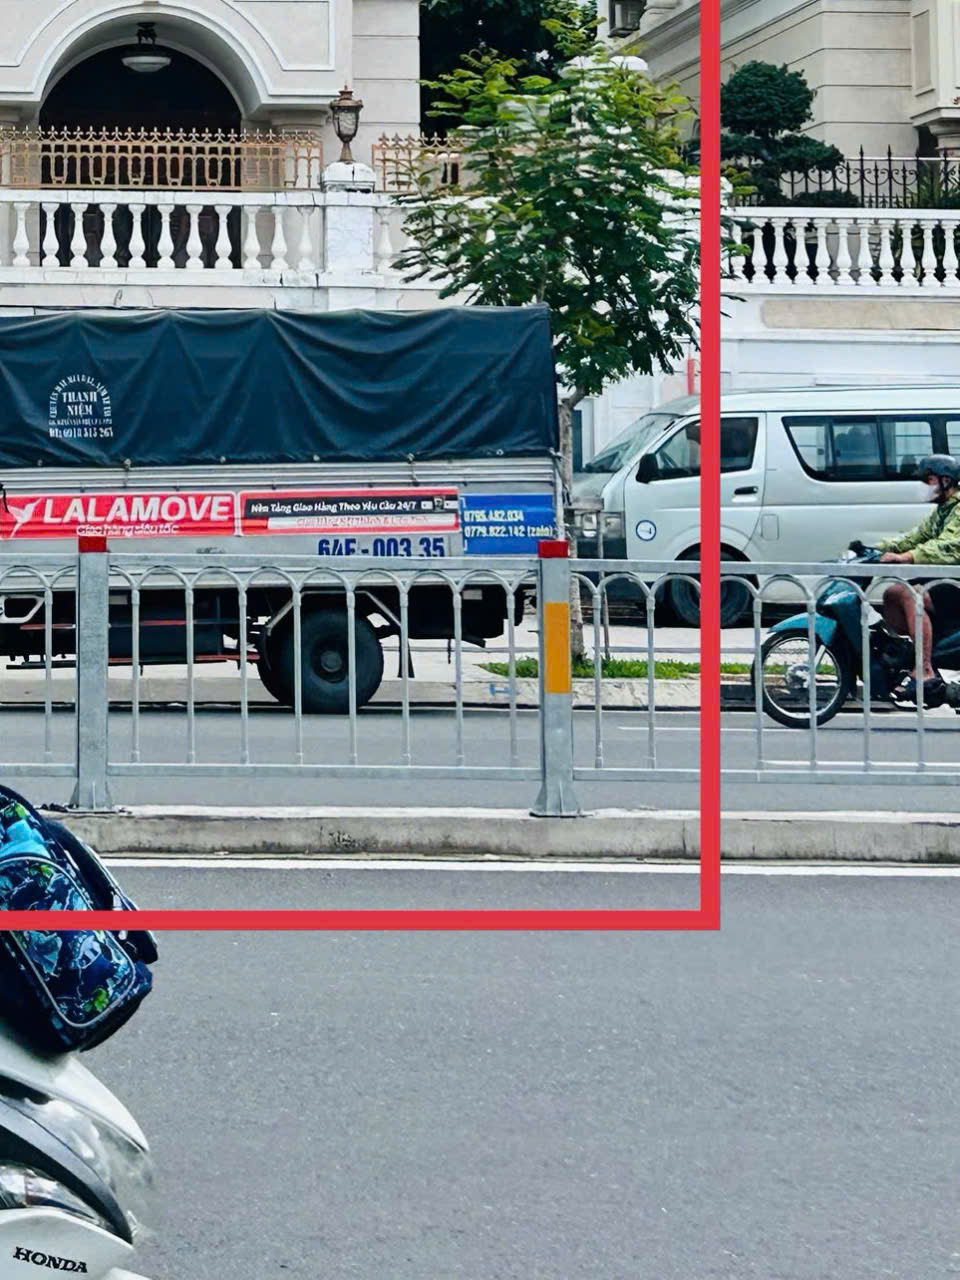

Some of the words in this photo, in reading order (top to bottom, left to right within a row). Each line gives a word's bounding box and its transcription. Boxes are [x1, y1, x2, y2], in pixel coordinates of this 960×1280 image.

[62, 391, 97, 403] THANH
[43, 496, 231, 523] LALAMOVE
[293, 502, 313, 512] Giao
[314, 501, 337, 513] Hàng
[339, 502, 361, 511] Theo
[397, 501, 417, 511] 24/7
[13, 1246, 88, 1273] HONDA
